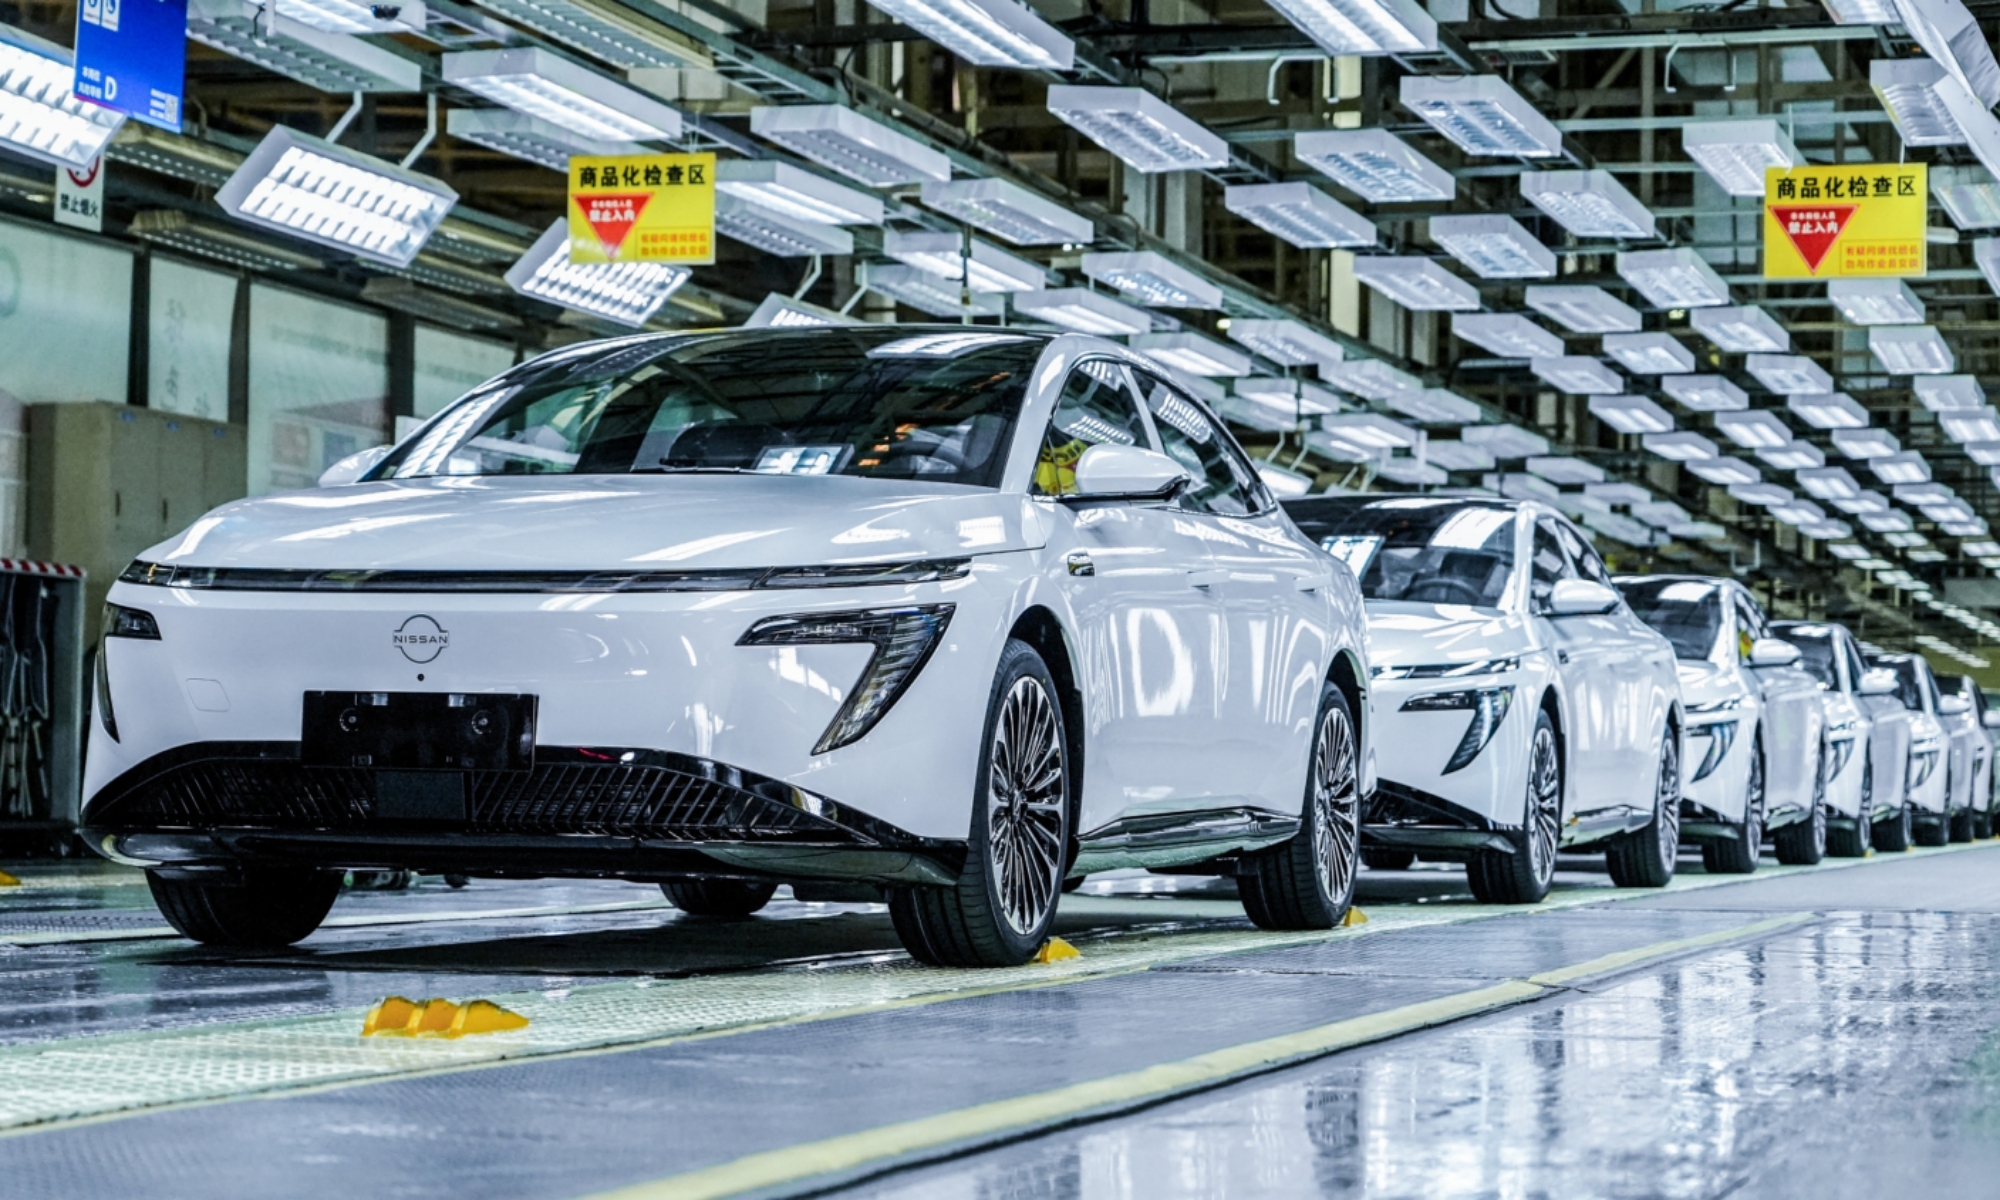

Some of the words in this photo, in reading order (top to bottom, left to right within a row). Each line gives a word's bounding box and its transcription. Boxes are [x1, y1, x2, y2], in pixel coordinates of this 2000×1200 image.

[104, 75, 117, 101] D
[579, 164, 706, 187] 商品化检查区
[1776, 175, 1917, 199] 商品化检查区
[1788, 221, 1838, 234] 禁止入内
[393, 635, 448, 644] NISSAN
